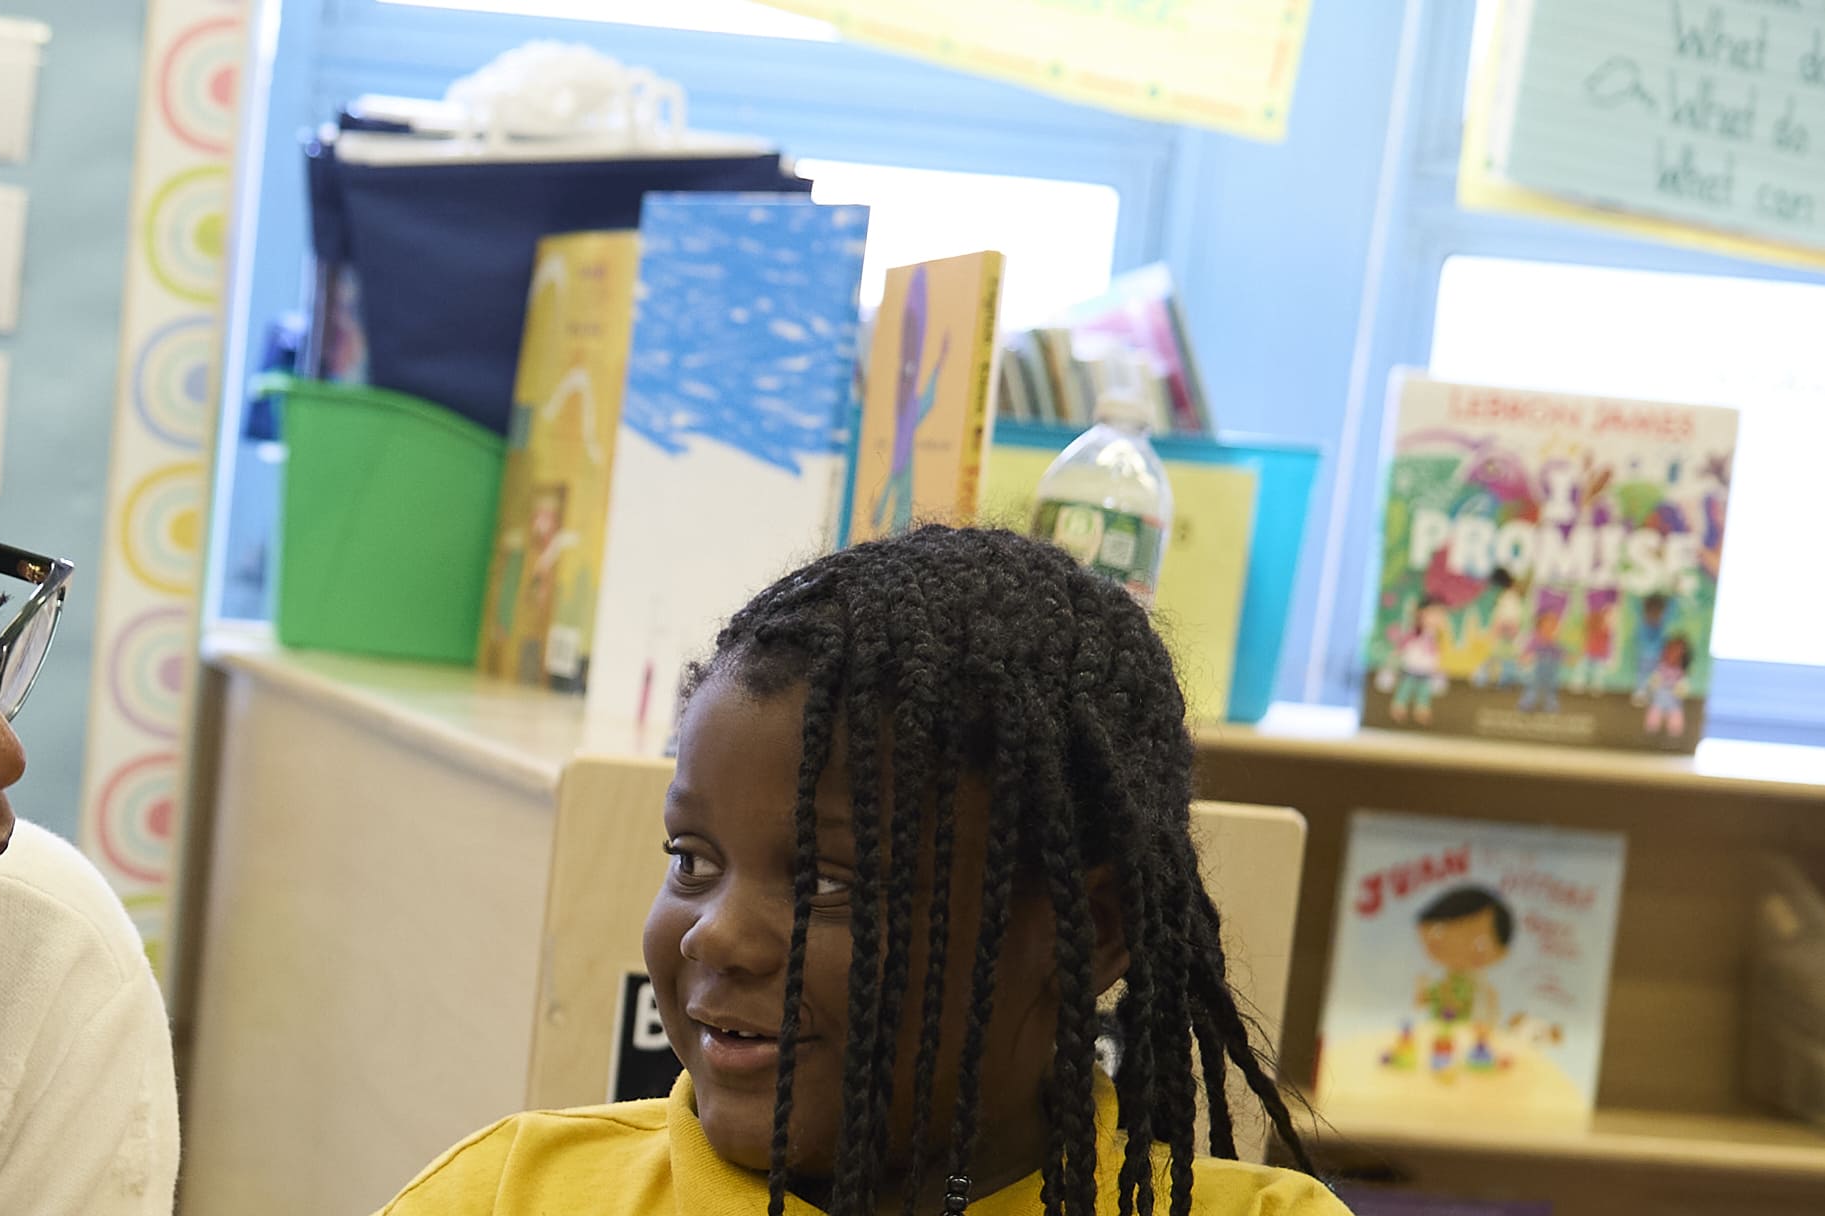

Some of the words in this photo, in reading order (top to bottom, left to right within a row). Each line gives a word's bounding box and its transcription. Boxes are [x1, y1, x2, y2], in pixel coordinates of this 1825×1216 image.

[1666, 65, 1758, 142] What
[1774, 93, 1811, 154] do
[1654, 135, 1736, 206] What
[1409, 505, 1701, 597] PROMISE
[1356, 841, 1472, 918] JUAN
